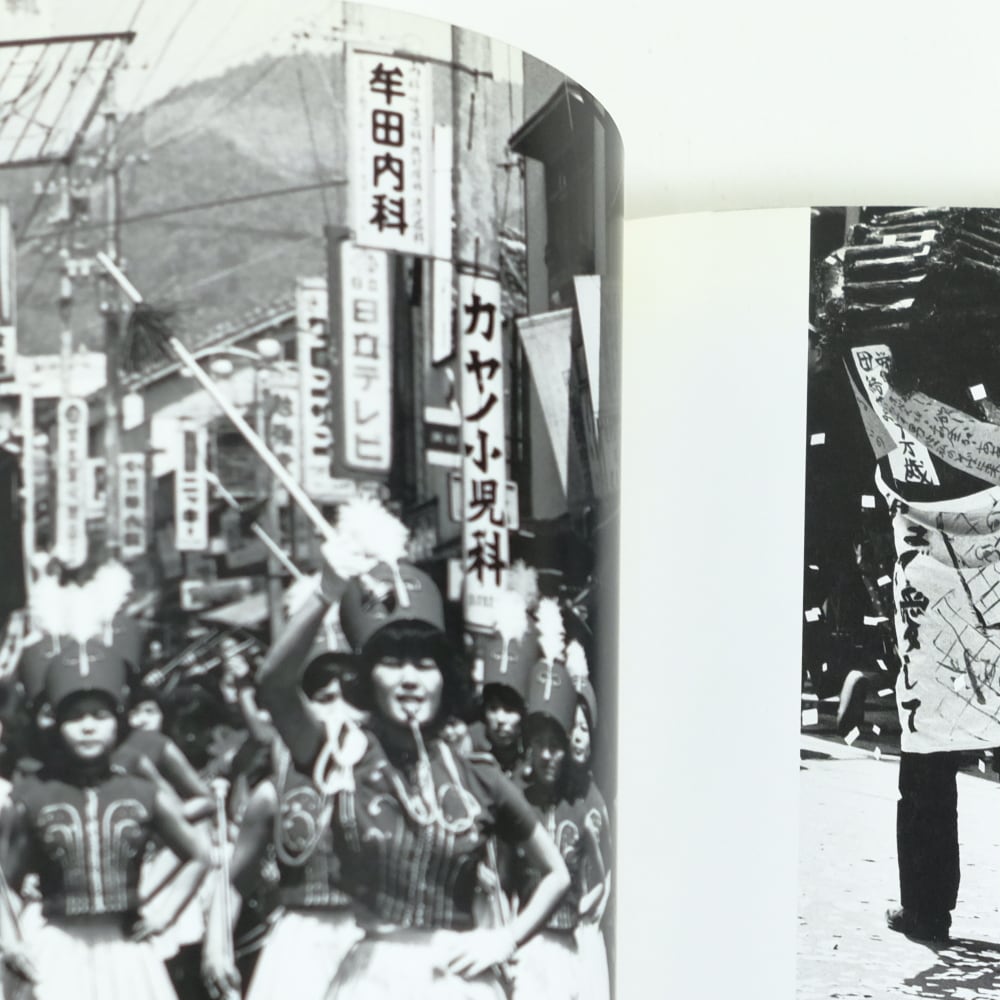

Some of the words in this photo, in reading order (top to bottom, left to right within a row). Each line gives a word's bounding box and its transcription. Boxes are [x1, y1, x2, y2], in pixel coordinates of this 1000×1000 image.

[369, 63, 408, 235] 牟田内科
[464, 294, 506, 587] カヤノ小児科
